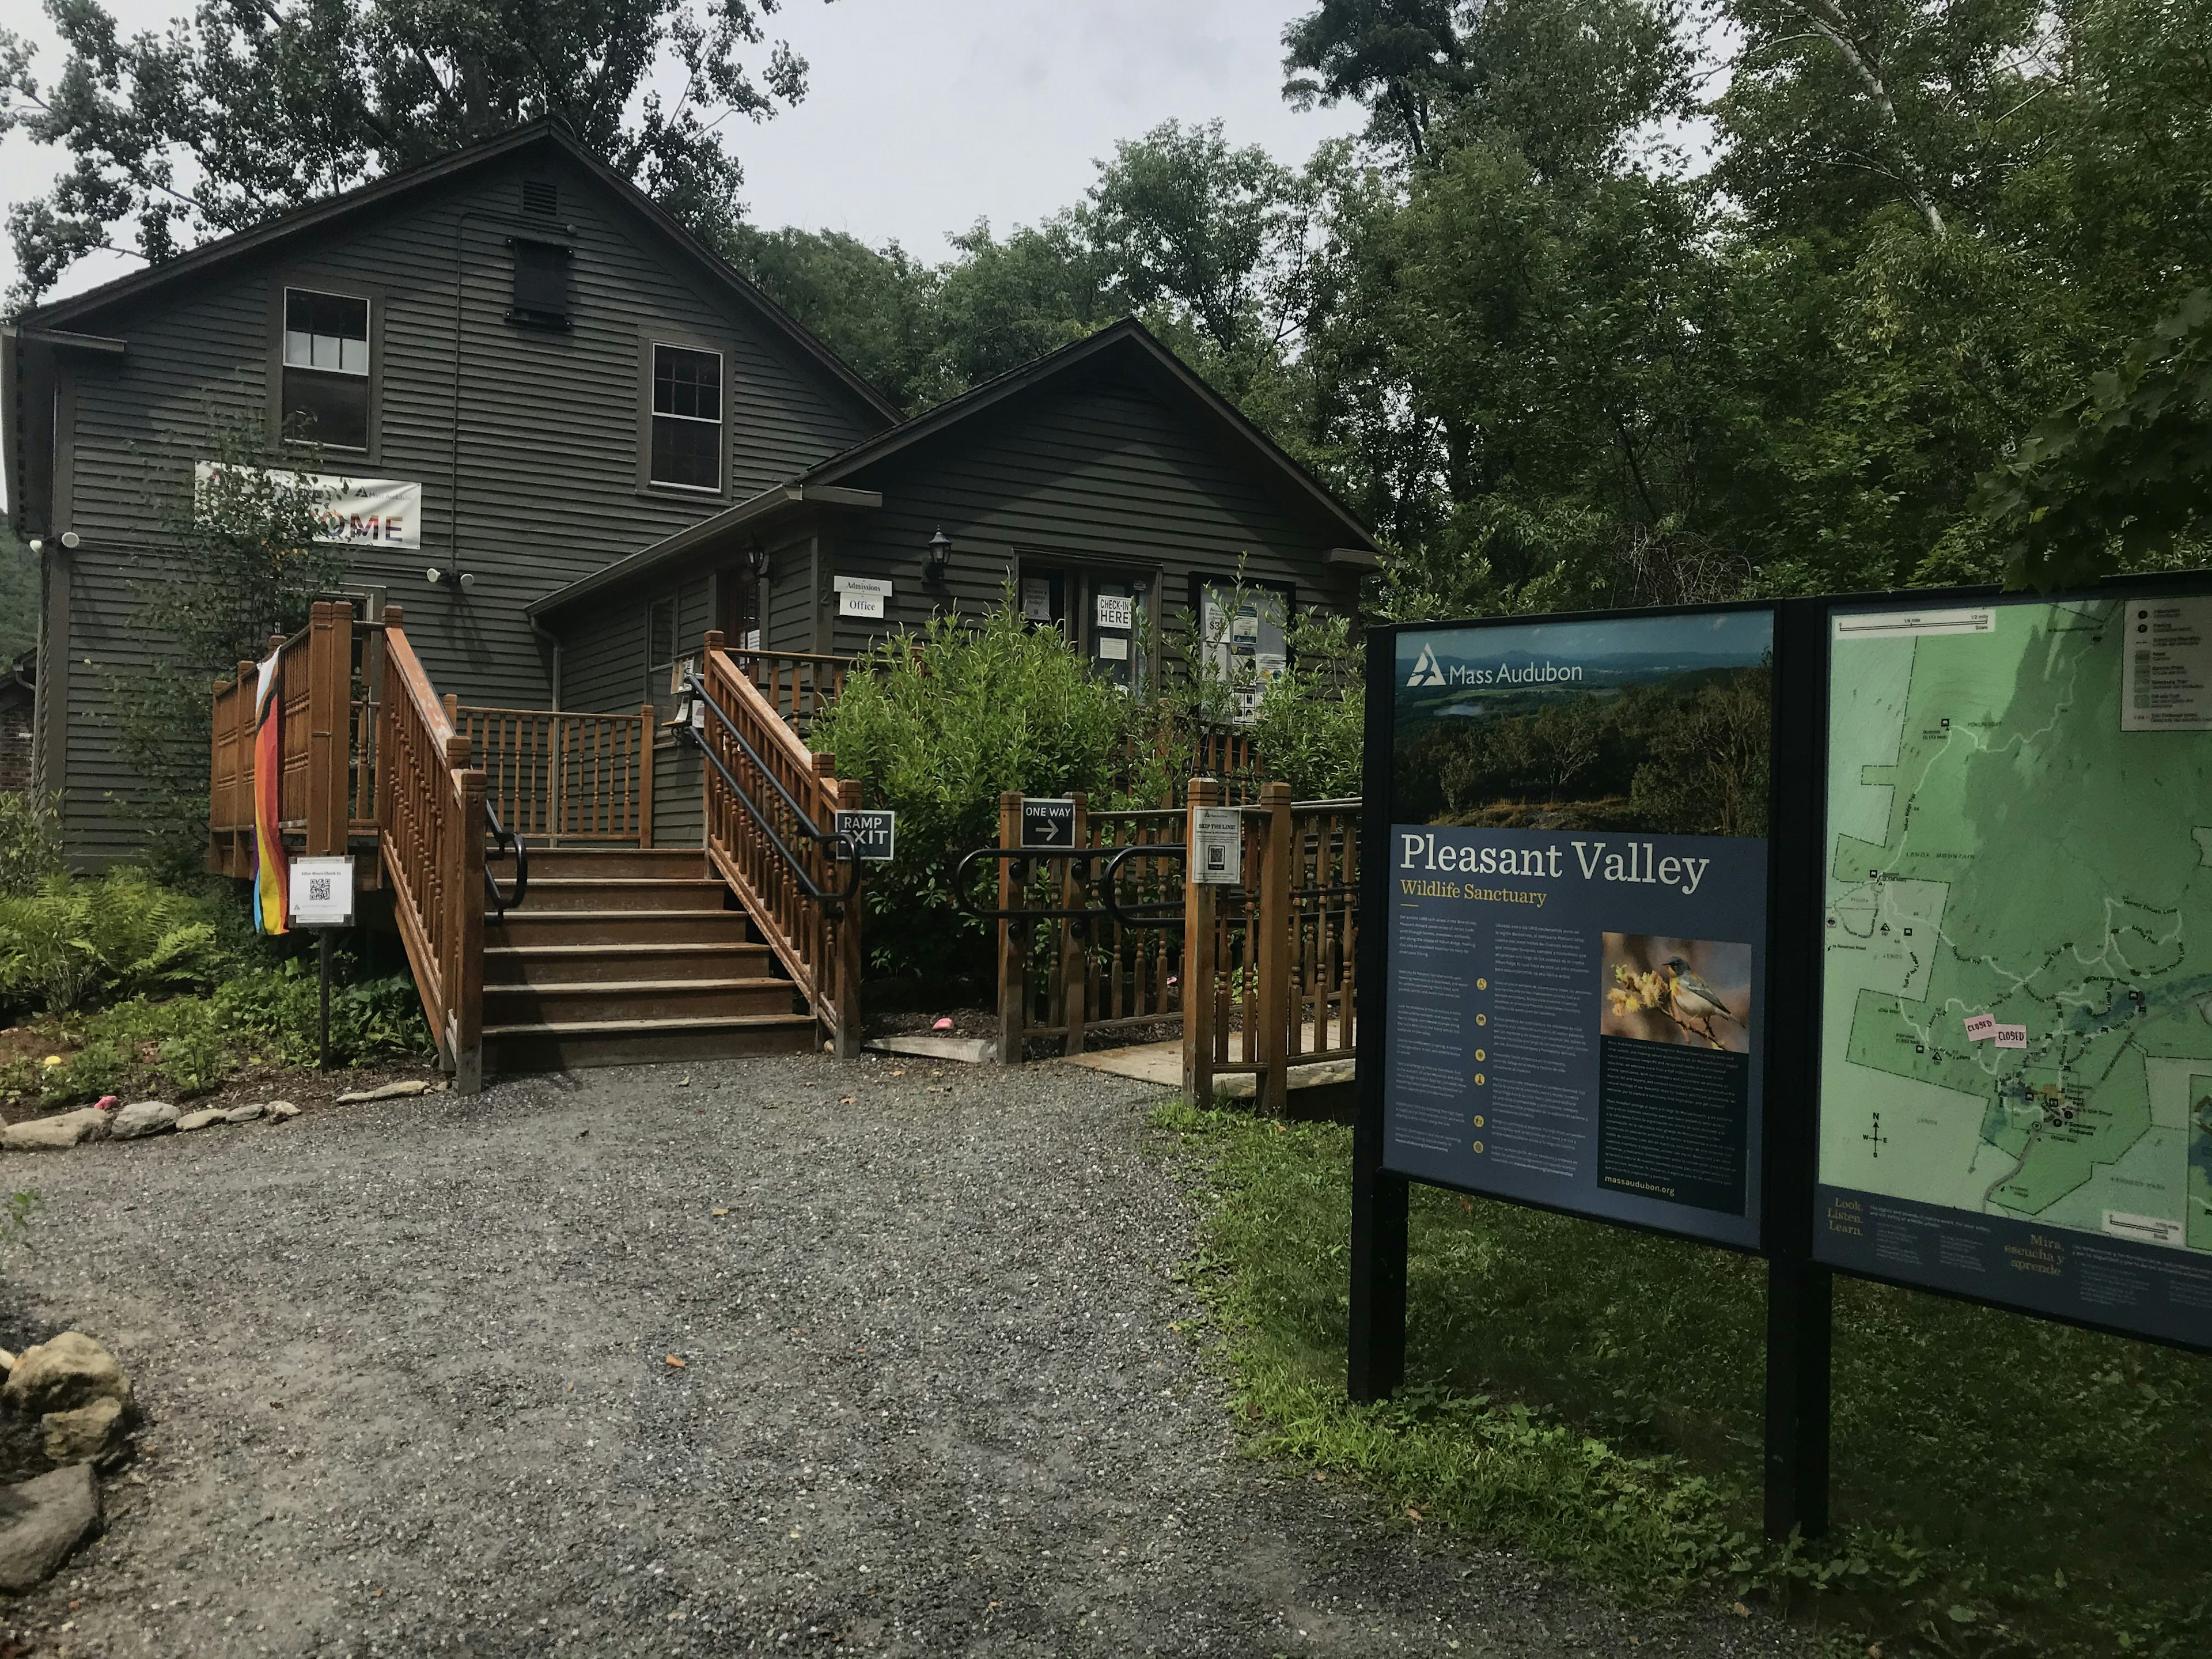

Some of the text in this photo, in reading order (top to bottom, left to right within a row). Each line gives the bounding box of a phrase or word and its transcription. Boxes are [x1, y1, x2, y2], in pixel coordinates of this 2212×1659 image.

[847, 582, 881, 592] Admissions
[850, 600, 876, 611] Office
[1100, 598, 1129, 611] CHECK-IN
[1101, 609, 1128, 624] HERE
[1449, 661, 1582, 685] Mass Audubon
[1025, 807, 1071, 817] ONE WAY
[844, 816, 882, 829] RAMP
[1400, 833, 1710, 895] Pleasant Valley
[1400, 879, 1547, 908] Wildlife Sanctuary
[1967, 1020, 1993, 1032] CLOSED
[1998, 1031, 2024, 1041] CLOSED
[1873, 1112, 1880, 1120] N
[1604, 1176, 1675, 1196] massaudubon.org
[1829, 1220, 1863, 1236] Learn.
[2004, 1244, 2055, 1262] escucha
